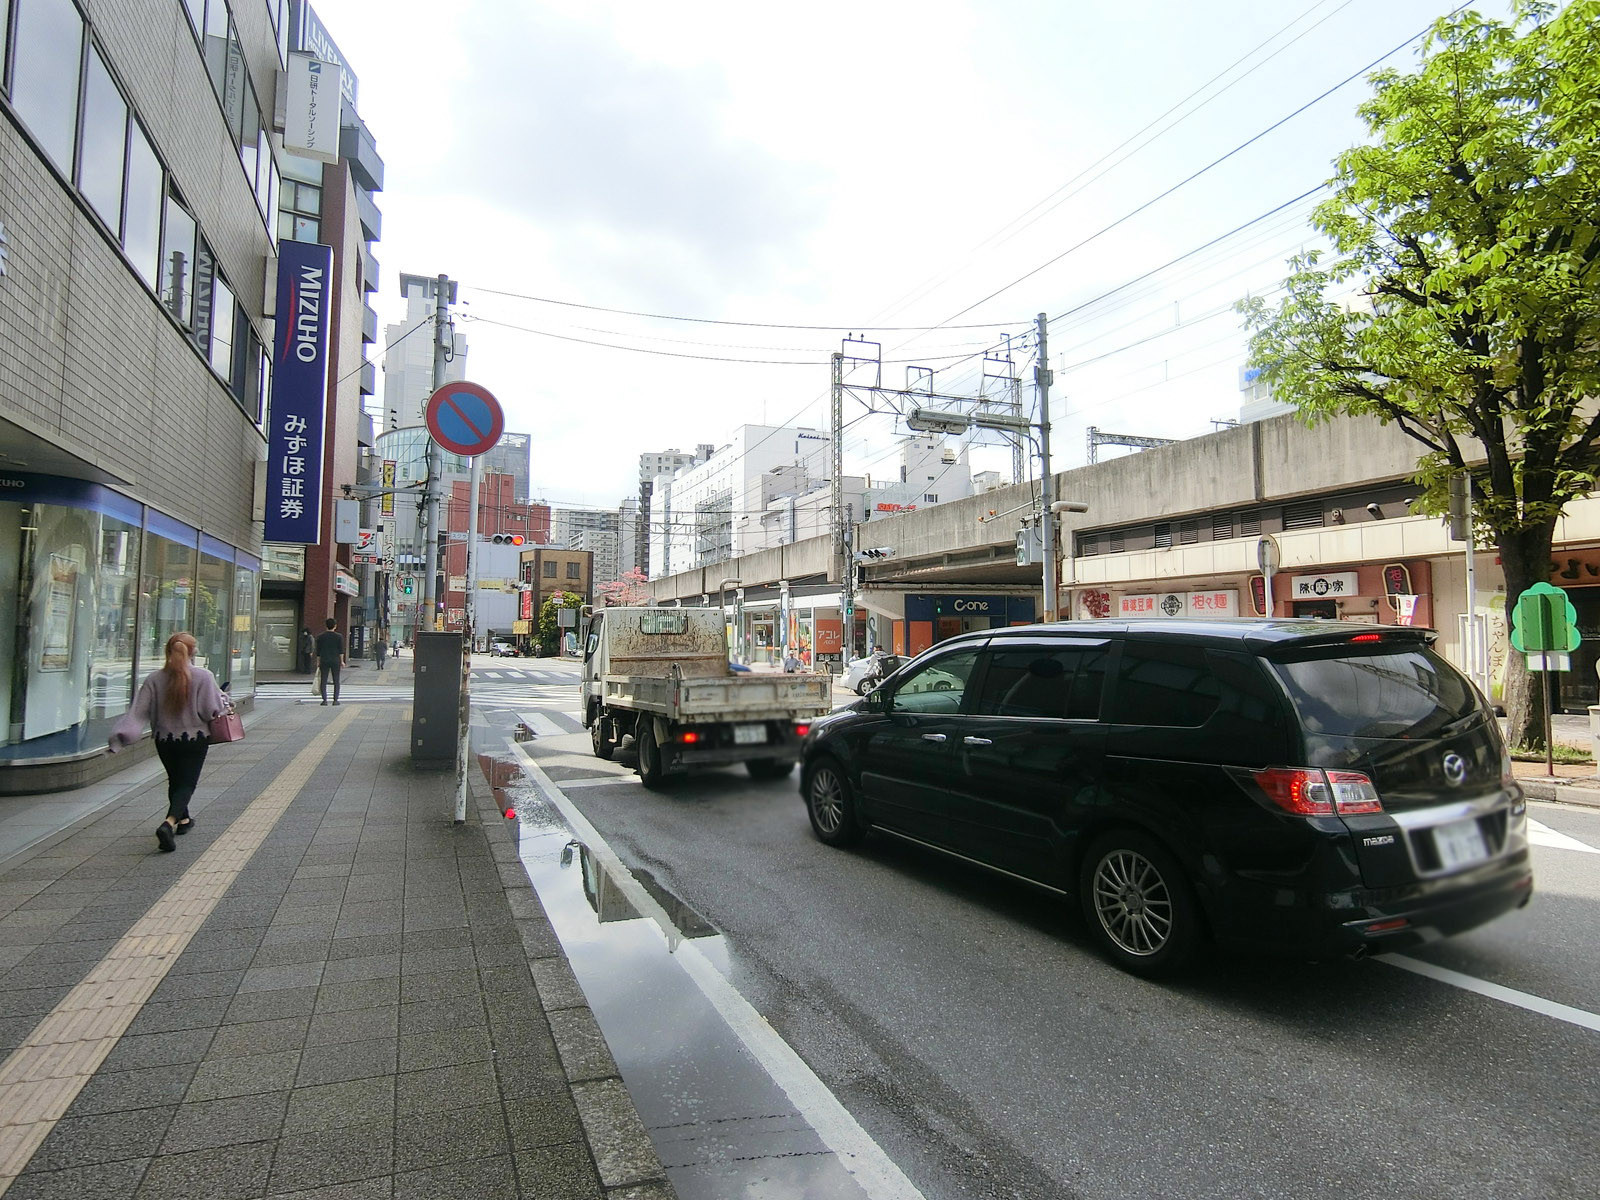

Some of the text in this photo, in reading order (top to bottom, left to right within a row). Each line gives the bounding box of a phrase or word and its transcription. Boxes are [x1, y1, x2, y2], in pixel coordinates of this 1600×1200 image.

[306, 74, 319, 149] 日研トータルソーシング
[296, 265, 323, 363] MIZUHO
[280, 414, 308, 519] みずほ証券
[1121, 597, 1154, 612] 麻婆豆腐
[817, 630, 841, 640] アコレ
[1362, 835, 1395, 847] mazda
